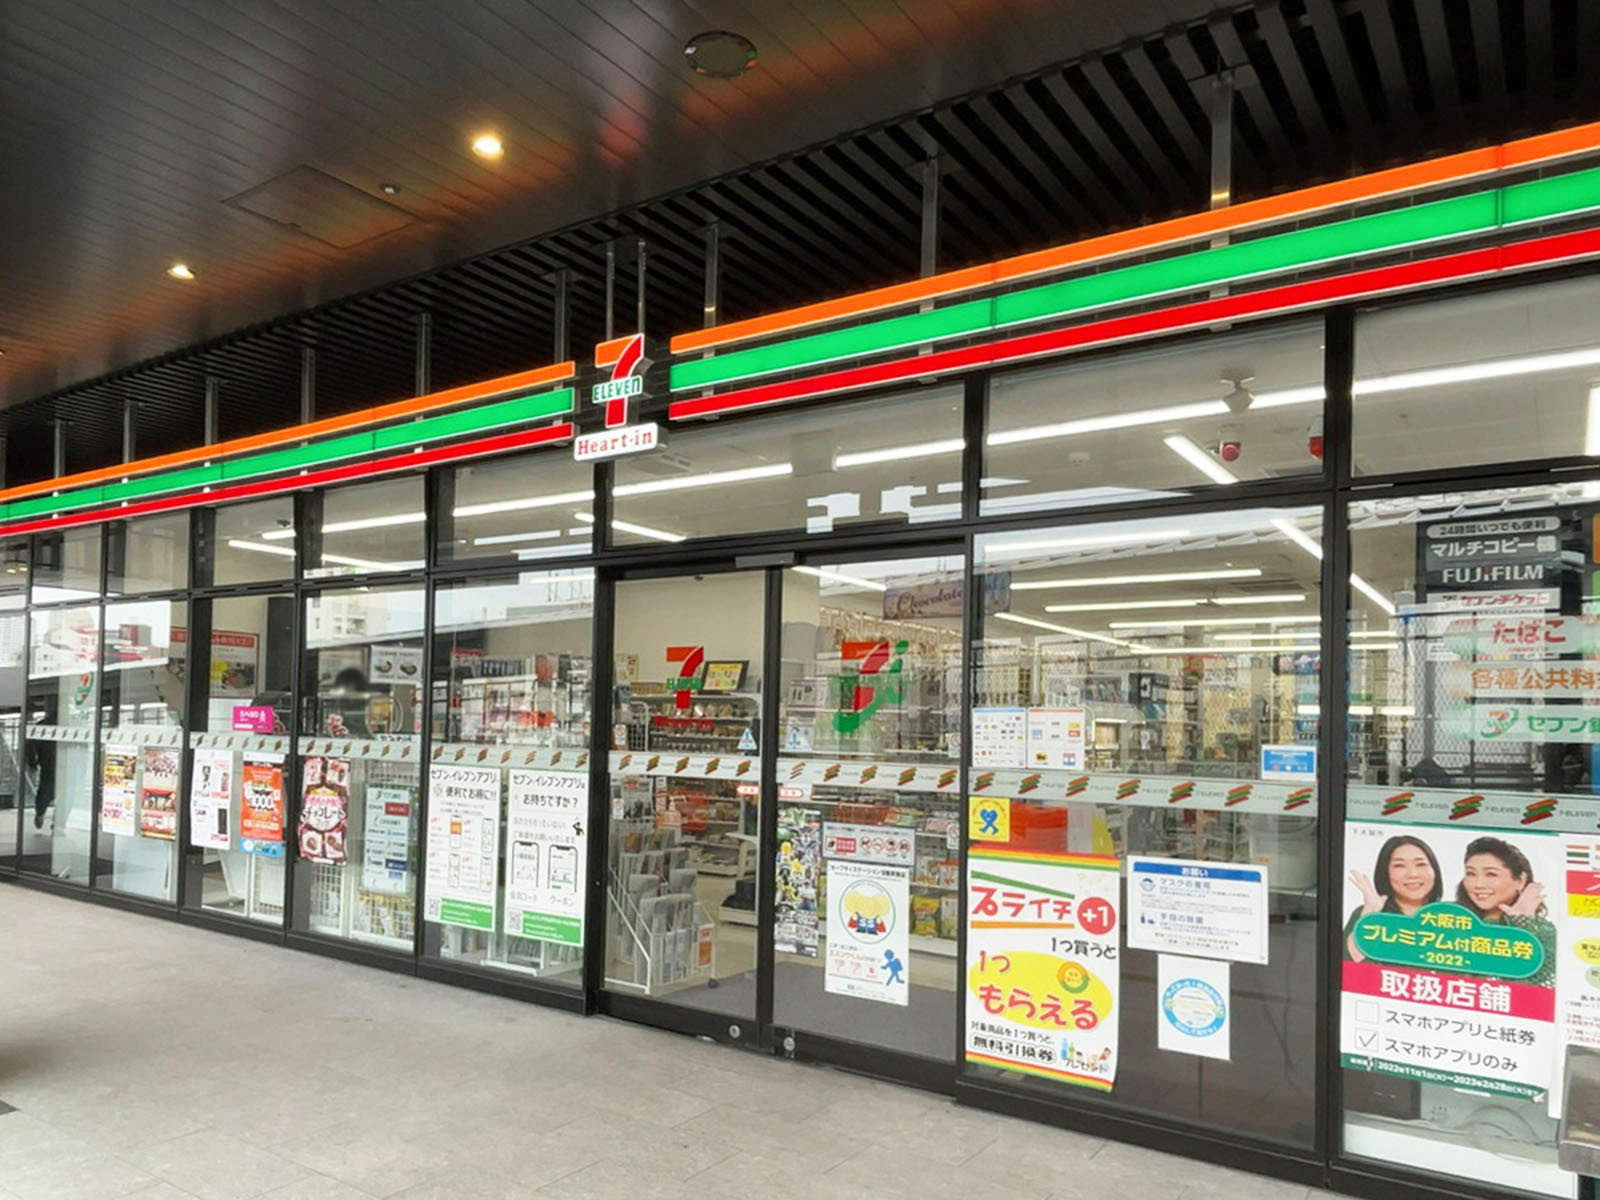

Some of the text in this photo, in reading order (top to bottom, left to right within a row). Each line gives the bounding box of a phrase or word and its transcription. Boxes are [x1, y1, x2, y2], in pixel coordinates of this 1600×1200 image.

[577, 431, 652, 455] Heart-in
[1440, 520, 1547, 535] 24時間いつでも便利
[1430, 535, 1557, 557] マルチコピー機
[1492, 619, 1567, 644] たばこ
[1472, 667, 1600, 690] 各種公共料
[1421, 912, 1473, 931] 大阪市
[1051, 937, 1117, 960] 1つ買うと
[1362, 924, 1533, 960] プレミアム付商品券
[979, 951, 1011, 973] 1つ
[1379, 968, 1512, 1014] 取扱店舗
[979, 984, 1099, 1031] もらえる
[1385, 1008, 1536, 1047] スマホアプリと紙券
[974, 1035, 1054, 1062] 無料引換券
[1384, 1037, 1519, 1072] スマホアプリのみ
